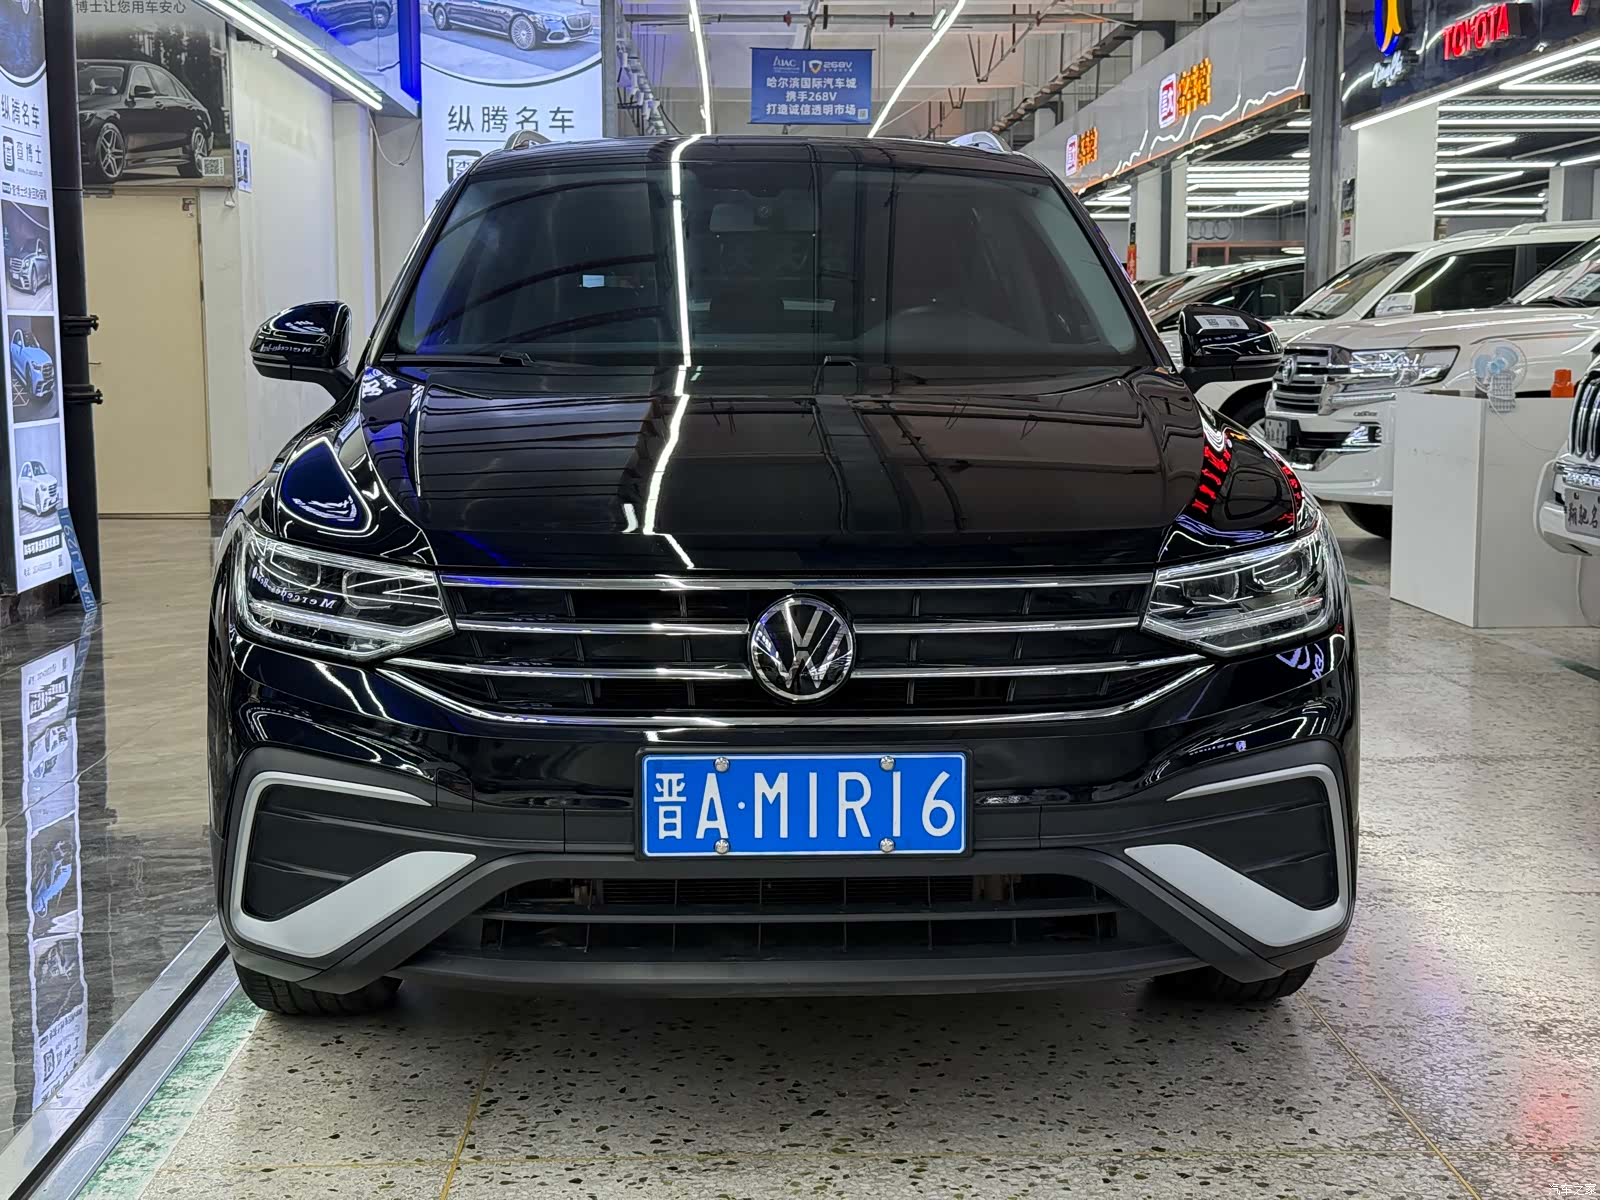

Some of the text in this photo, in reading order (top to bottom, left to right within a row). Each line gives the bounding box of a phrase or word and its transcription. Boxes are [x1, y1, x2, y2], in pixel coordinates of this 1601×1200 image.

[75, 0, 186, 13] 博士让您用车安心
[1442, 3, 1509, 60] TOYOTA
[823, 61, 853, 69] 268V
[766, 77, 857, 89] 哈尔滨国际汽车城
[785, 91, 838, 102] 携手268V
[766, 103, 856, 115] 打造诚信透明市场
[447, 105, 575, 134] 纵腾名车
[654, 771, 956, 839] 晋A·M1R16
